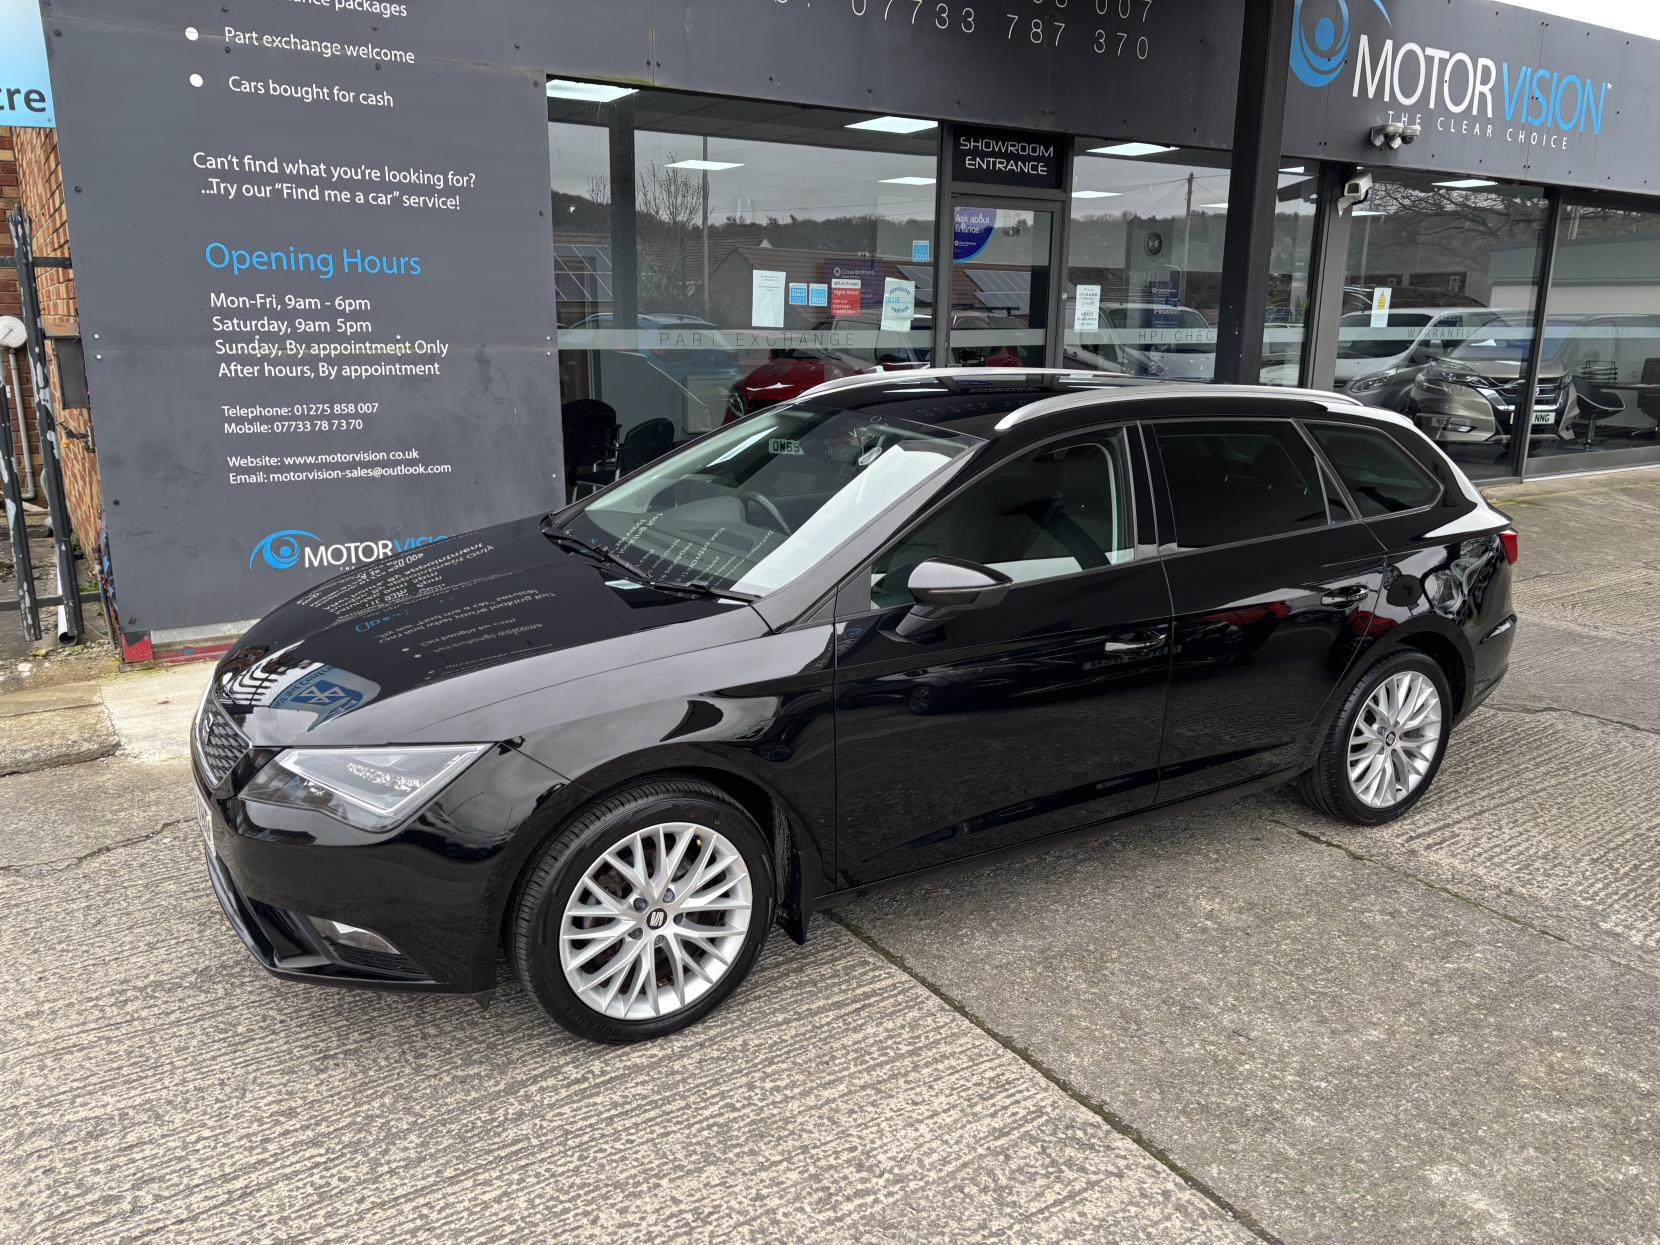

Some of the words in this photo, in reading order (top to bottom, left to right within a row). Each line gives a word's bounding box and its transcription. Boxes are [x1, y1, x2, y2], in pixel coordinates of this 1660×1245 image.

[334, 0, 408, 18] packages
[224, 27, 259, 46] Part
[262, 32, 341, 58] exchange
[344, 42, 415, 64] welcome
[1006, 14, 1066, 47] 787
[1093, 29, 1149, 60] 370
[0, 87, 47, 113] re
[228, 75, 265, 95] Cars
[269, 79, 330, 104] bought
[333, 84, 356, 103] for
[359, 89, 394, 108] cash
[1437, 116, 1494, 138] CLEAR
[1506, 128, 1568, 150] CHOICE
[959, 136, 1054, 158] SHOWROOM
[192, 151, 241, 172] Can't
[243, 153, 280, 175] find
[283, 157, 327, 178] what
[330, 162, 382, 183] you're
[384, 164, 444, 189] looking
[447, 170, 476, 189] for?
[965, 155, 1048, 175] ENTRANCE
[241, 183, 272, 199] our
[275, 183, 320, 202] "Find
[324, 189, 352, 204] me
[355, 193, 364, 205] a
[368, 190, 400, 207] car"
[402, 194, 461, 210] service!
[204, 242, 334, 279] Opening
[341, 248, 422, 276] Hours
[209, 291, 282, 311] Mon-Fri,
[284, 294, 321, 310] 9am
[334, 295, 371, 314] 6pm
[212, 315, 291, 335] Saturday,
[295, 318, 331, 333] 9am
[336, 318, 372, 335] 5pm
[1138, 330, 1164, 342] HPI
[1174, 329, 1215, 342] CHEC
[215, 339, 282, 358] Sunday,
[286, 340, 306, 358] By
[310, 340, 411, 358] appointment
[414, 339, 449, 358] Only
[659, 332, 718, 347] PART
[736, 332, 855, 347] EXCHANGE
[218, 361, 260, 378] After
[264, 362, 315, 379] hours,
[318, 362, 338, 379] By
[341, 361, 440, 379] appointment
[221, 404, 292, 419] Telephone:
[294, 403, 331, 416] 01275
[333, 403, 356, 415] 858
[357, 402, 379, 414] 007
[224, 421, 272, 434] Mobile:
[273, 421, 311, 433] 07733
[227, 454, 282, 468] Website:
[229, 471, 267, 485] Email:
[269, 463, 452, 483] motorvision-sales@outlook.com
